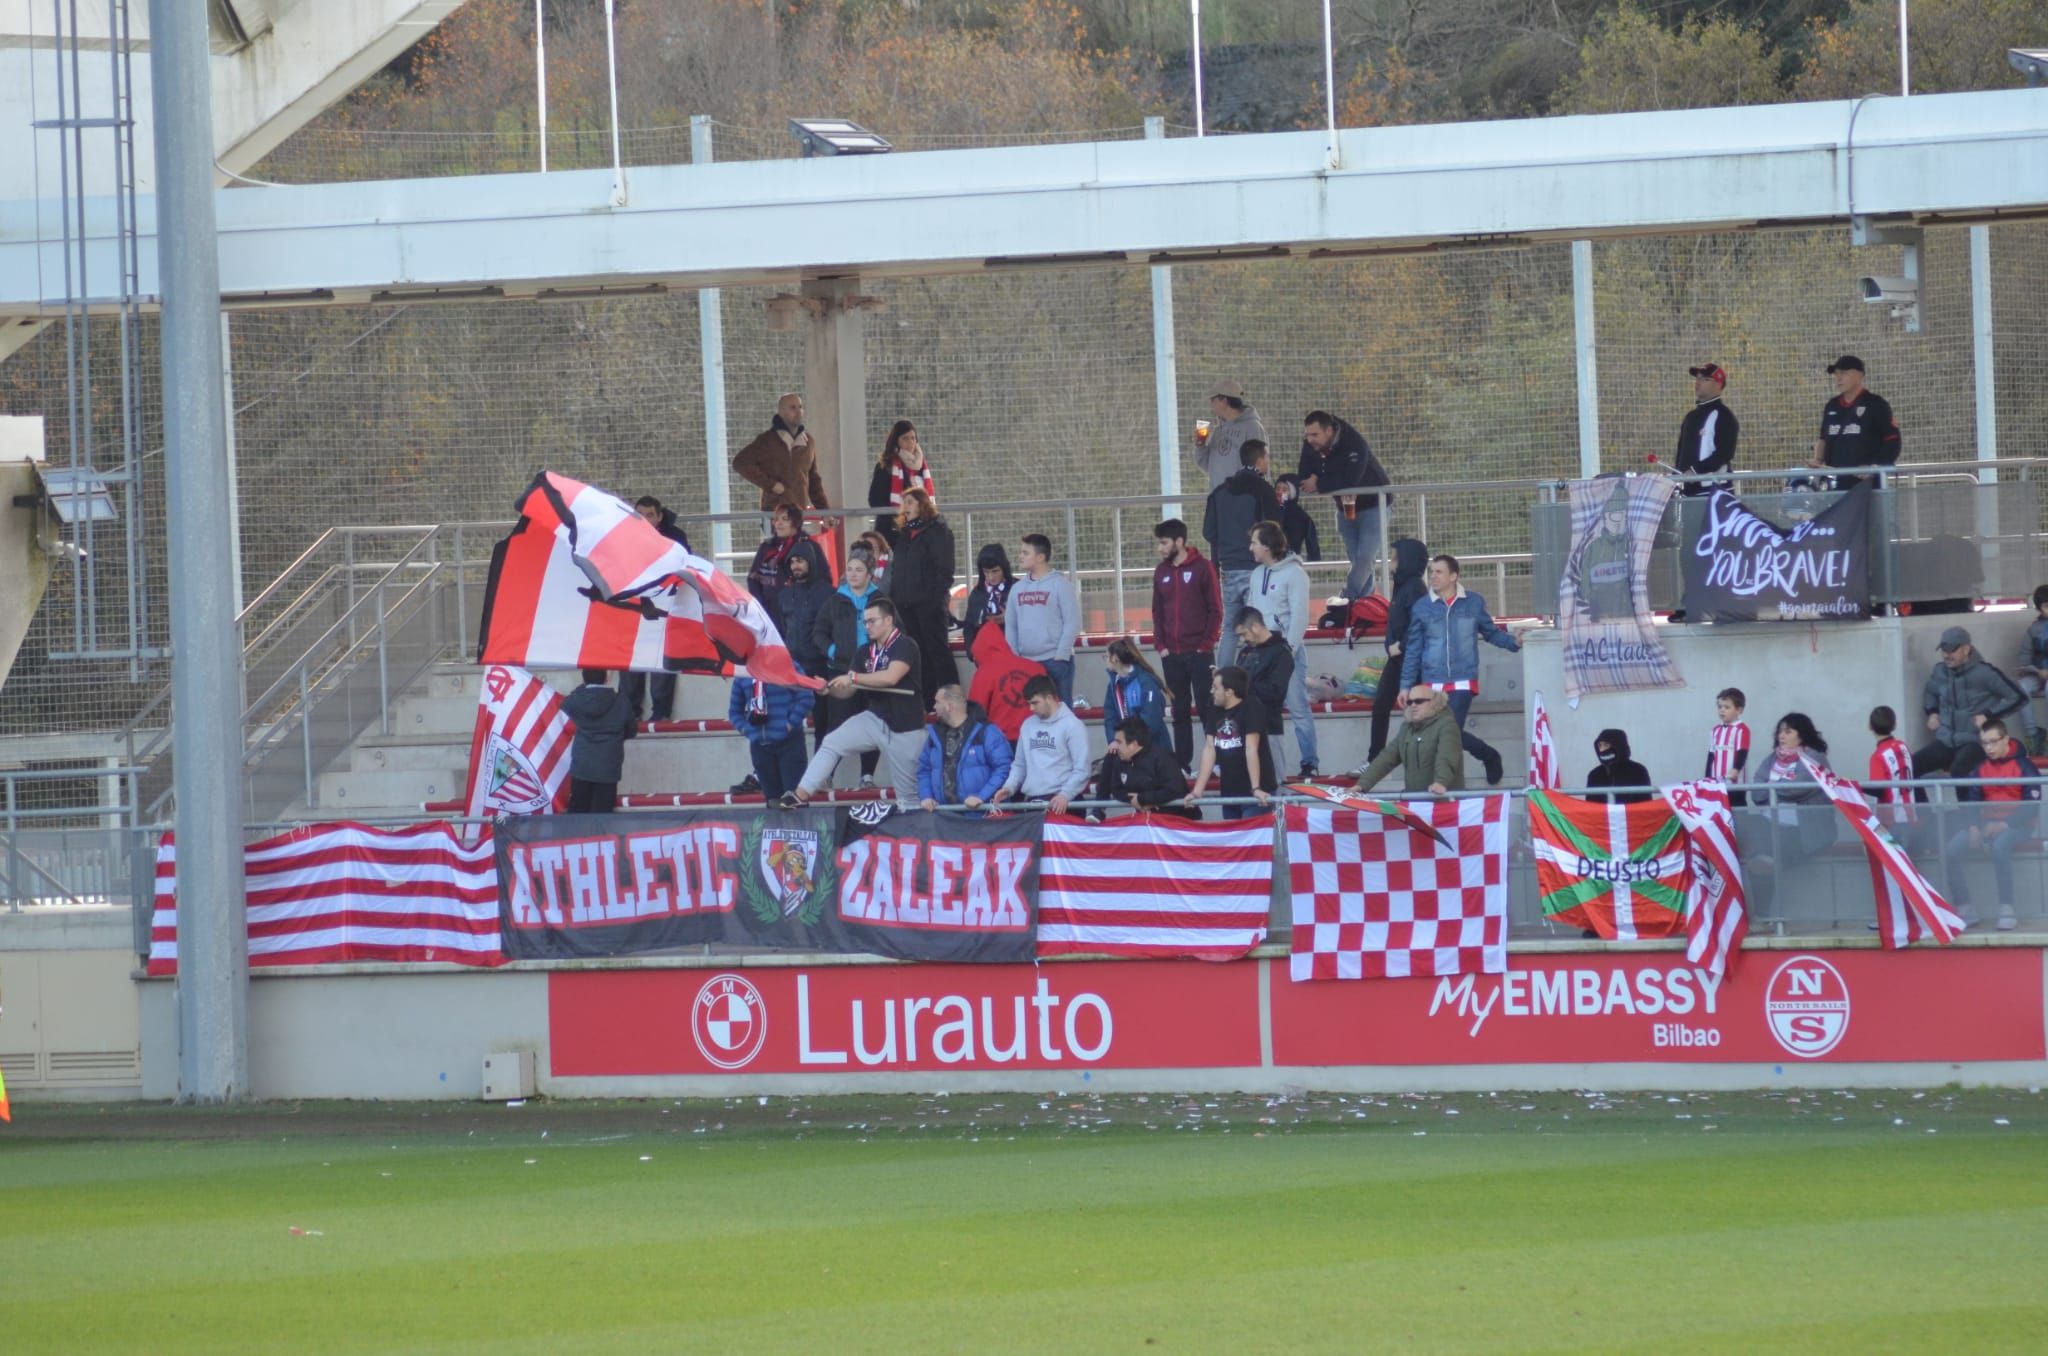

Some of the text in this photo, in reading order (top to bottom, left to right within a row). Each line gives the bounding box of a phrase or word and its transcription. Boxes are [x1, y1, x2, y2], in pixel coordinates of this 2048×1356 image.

[508, 824, 1032, 931] ATHLETIC ZALEAK
[1577, 856, 1661, 882] DEUSTO
[701, 980, 757, 1008] BMW
[796, 974, 1114, 1064] Lurauto
[1652, 1023, 1721, 1047] Bilbao
